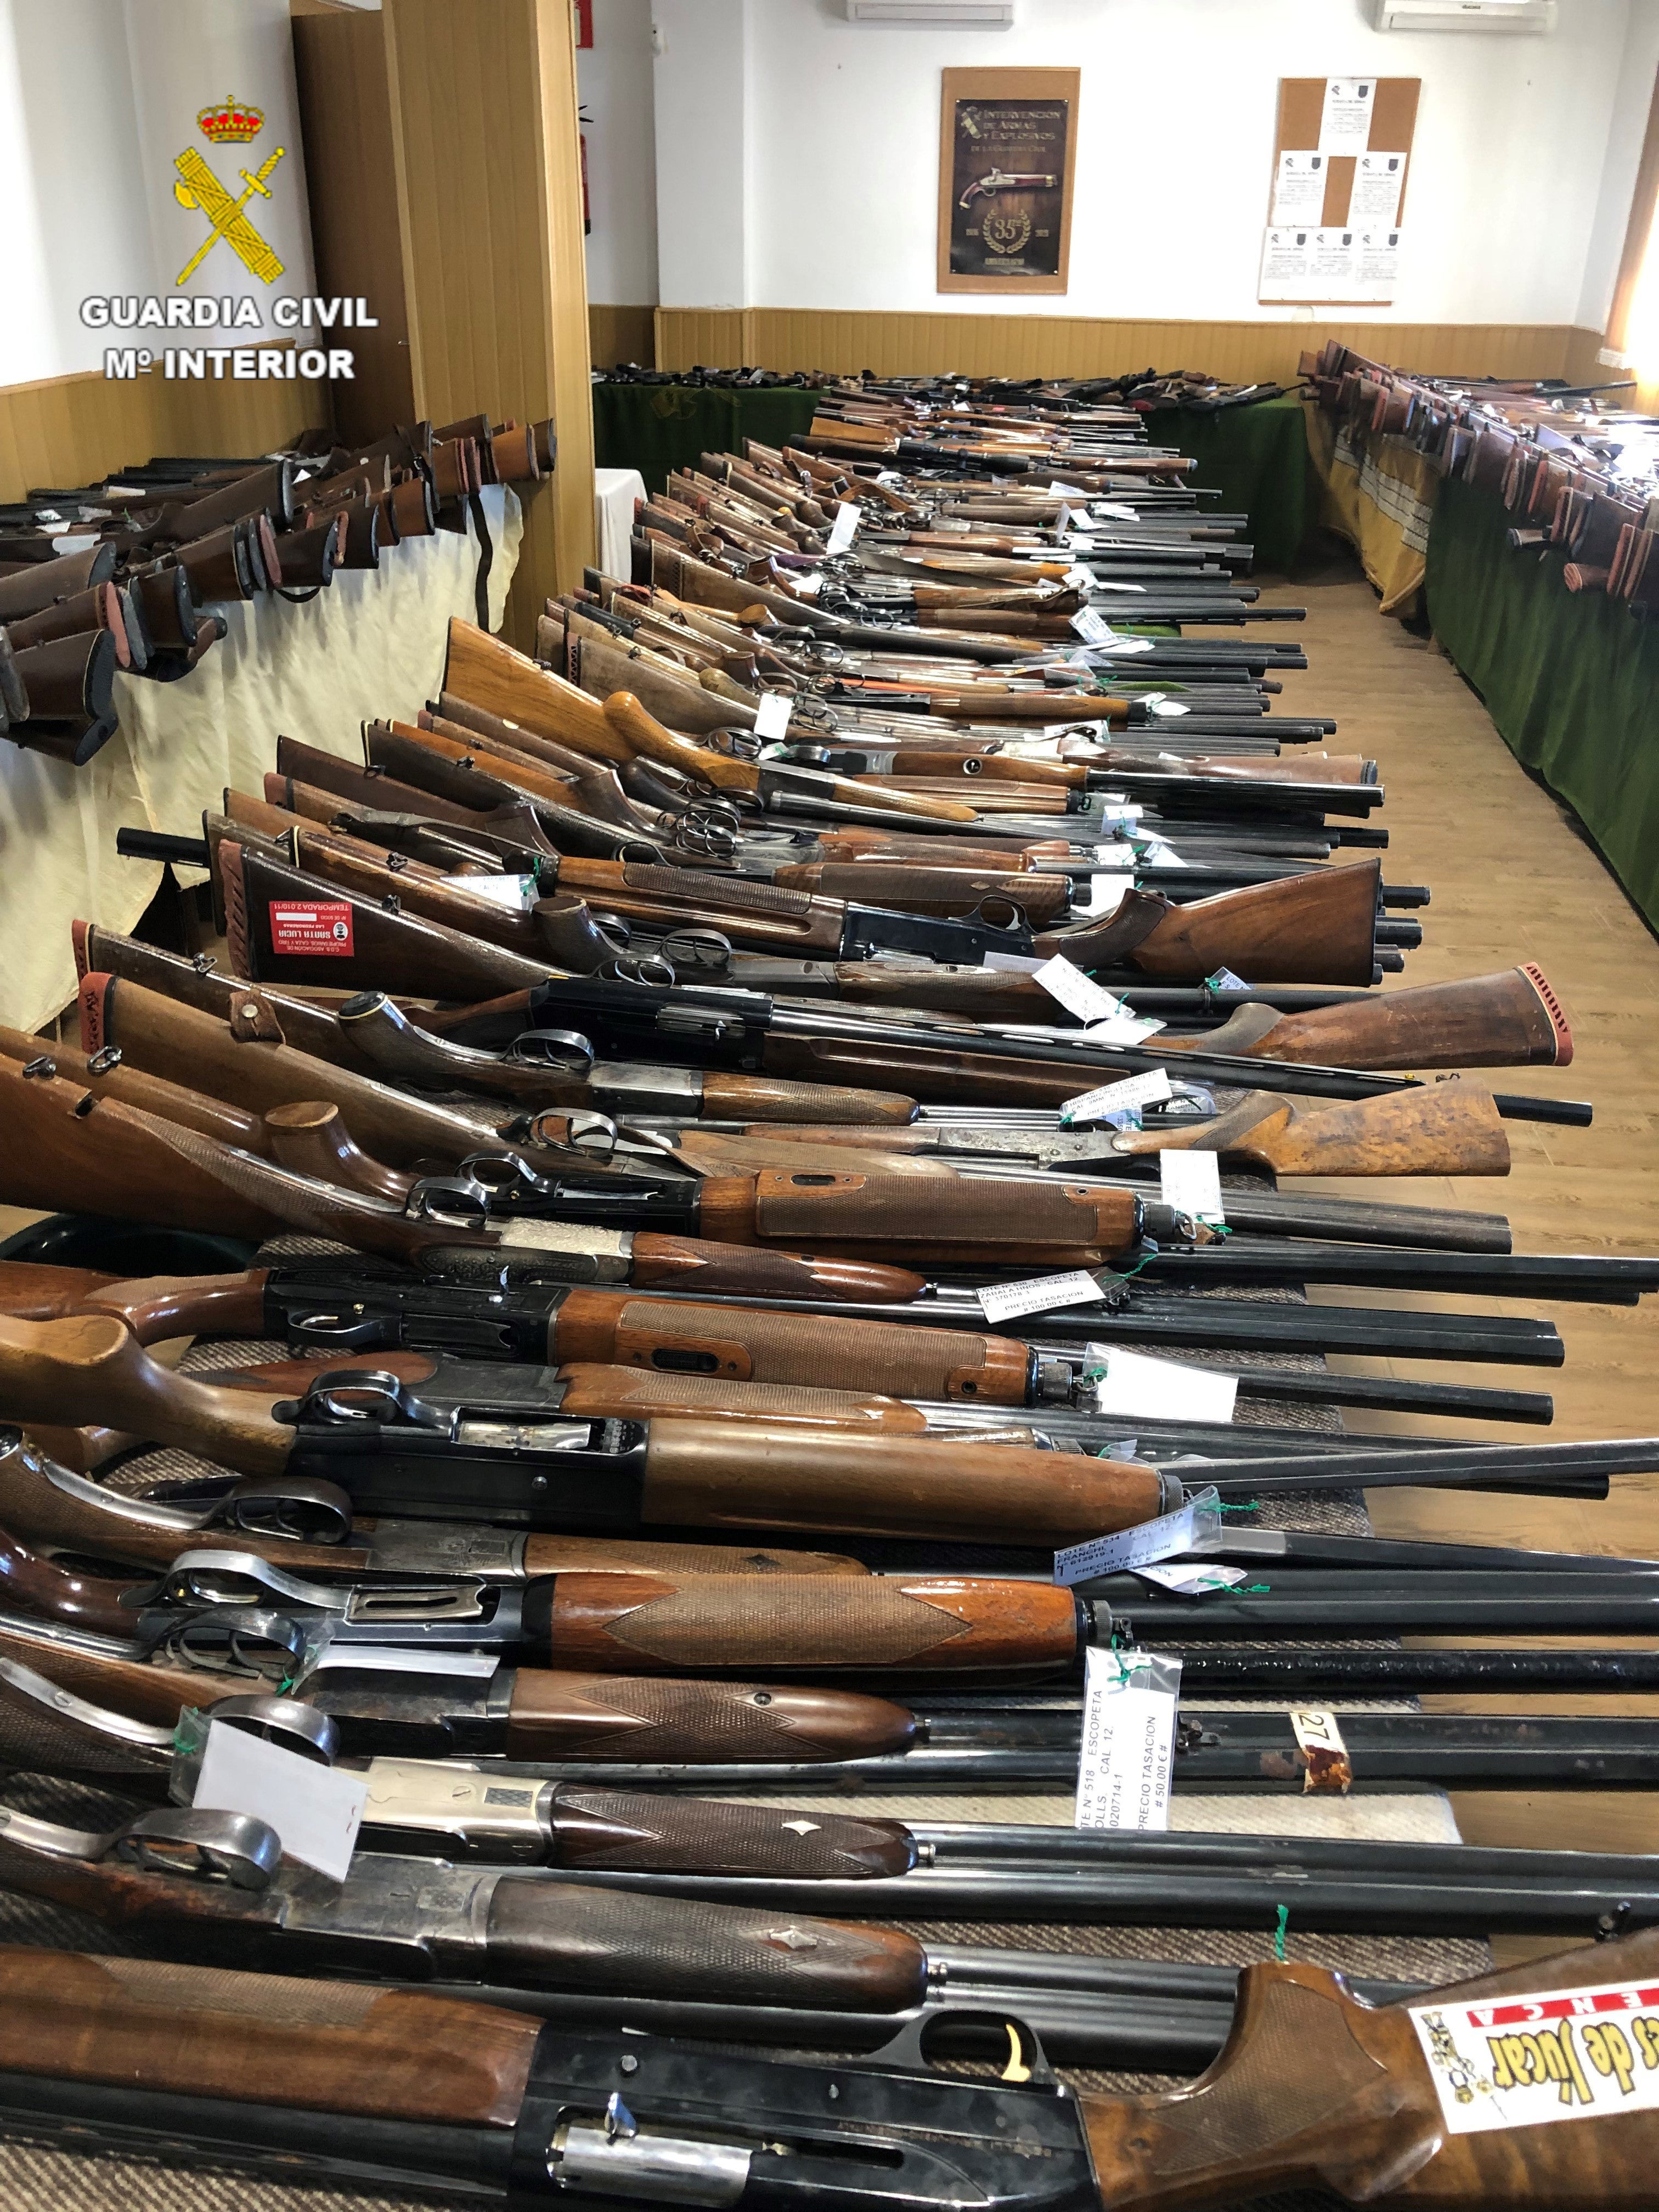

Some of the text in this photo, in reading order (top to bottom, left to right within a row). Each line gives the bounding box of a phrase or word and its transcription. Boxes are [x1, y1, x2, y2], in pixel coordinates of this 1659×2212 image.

[303, 930, 331, 939] SANTA
[977, 1285, 1001, 1293] LOTE
[1033, 1272, 1080, 1284] ESCOPETA
[1005, 1291, 1084, 1311] PRECIO TASACION
[1058, 1545, 1085, 1558] LOTE
[1075, 1543, 1171, 1575] PRECIO TASACION
[1087, 1690, 1102, 1756] ESCOPETA
[1084, 1769, 1096, 1791] 518
[1138, 1716, 1156, 1830] PRECIO TASACION
[1485, 2017, 1595, 2107] Júcar
[1581, 2022, 1635, 2096] de
